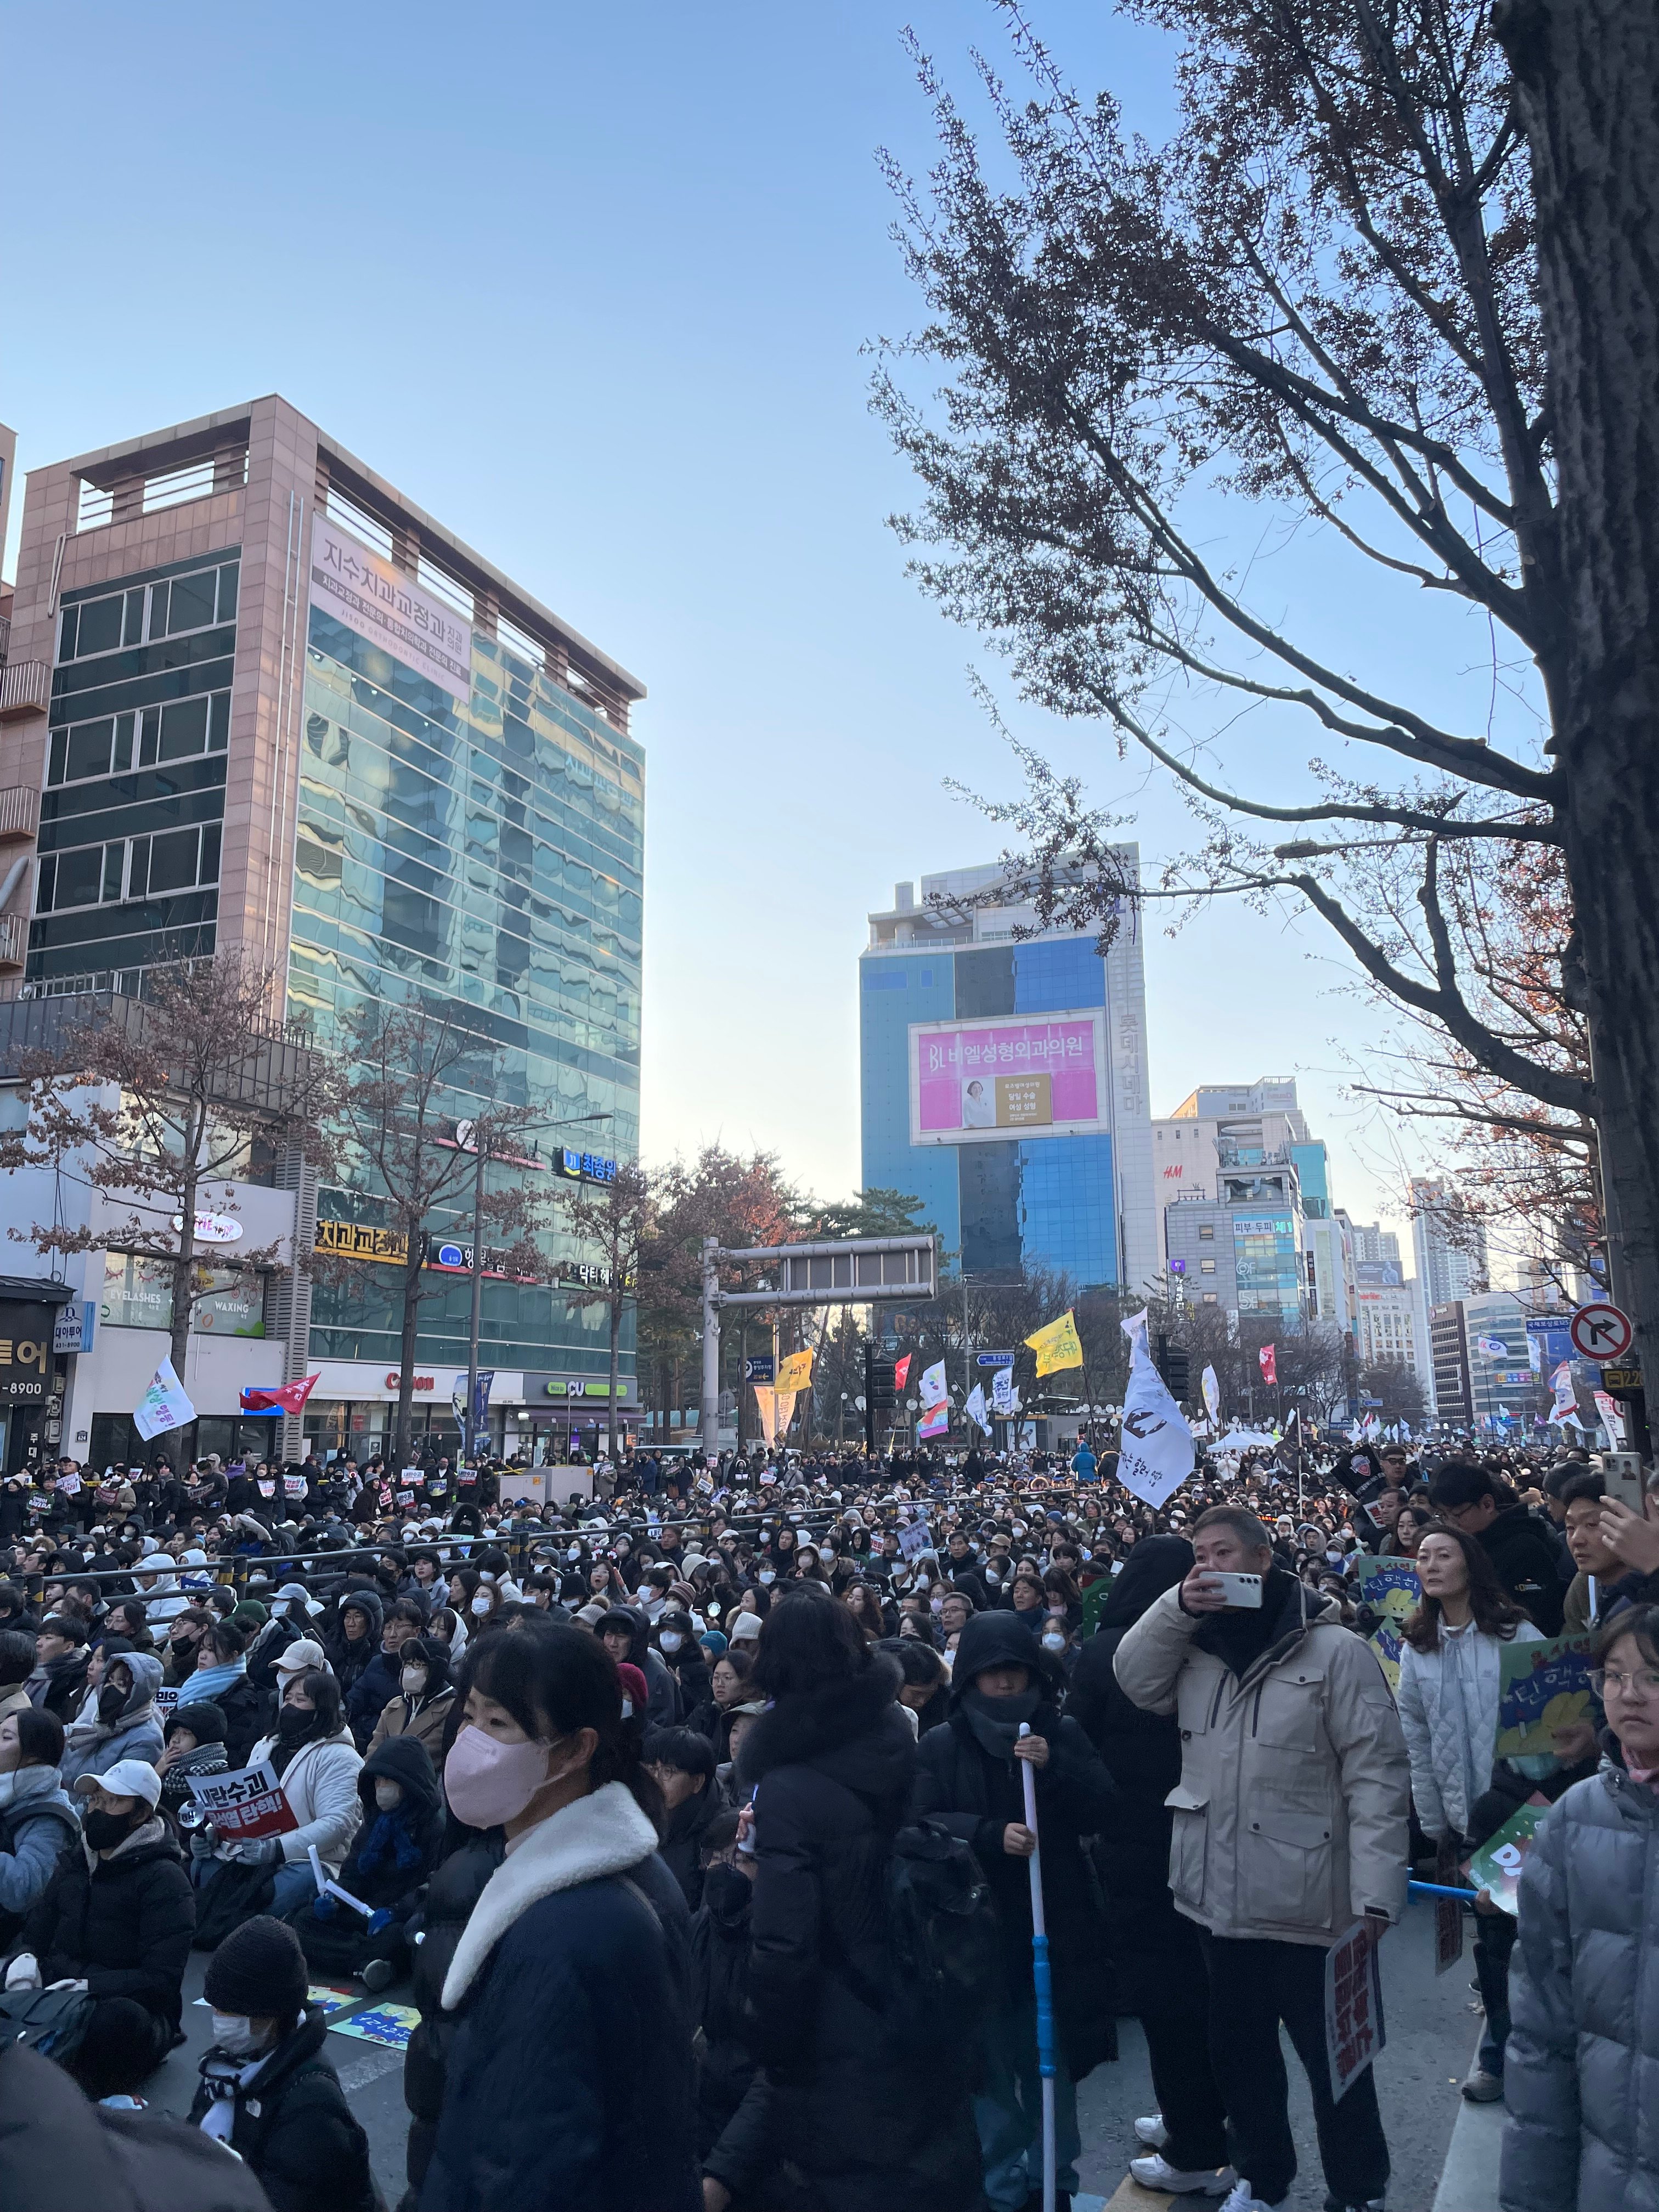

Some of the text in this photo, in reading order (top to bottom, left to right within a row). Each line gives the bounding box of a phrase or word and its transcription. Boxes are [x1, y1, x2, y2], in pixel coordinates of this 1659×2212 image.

[324, 538, 446, 642] 지수치과교정과
[323, 575, 360, 609] 치과교정과
[429, 644, 448, 667] 전문의
[450, 661, 461, 676] 진료
[342, 609, 364, 629] JISOO
[422, 661, 445, 682] CLINIC
[929, 1036, 1082, 1071] BL 비엘성형외과의원
[1120, 1014, 1143, 1114] 롯데시네마
[1008, 1092, 1021, 1101] 당일
[1024, 1102, 1036, 1110] 성형
[110, 1290, 161, 1304] EYELASHES
[1238, 1290, 1257, 1310] 5F
[215, 1301, 249, 1313] WAXING
[55, 1325, 82, 1339] 대아투어
[0, 1383, 42, 1395] -8900
[385, 1372, 435, 1391] Cnon
[567, 1380, 584, 1396] CU
[1369, 1573, 1418, 1591] 탄핵하
[198, 1770, 269, 1809] 내란수괴
[239, 1791, 283, 1826] 탄핵!
